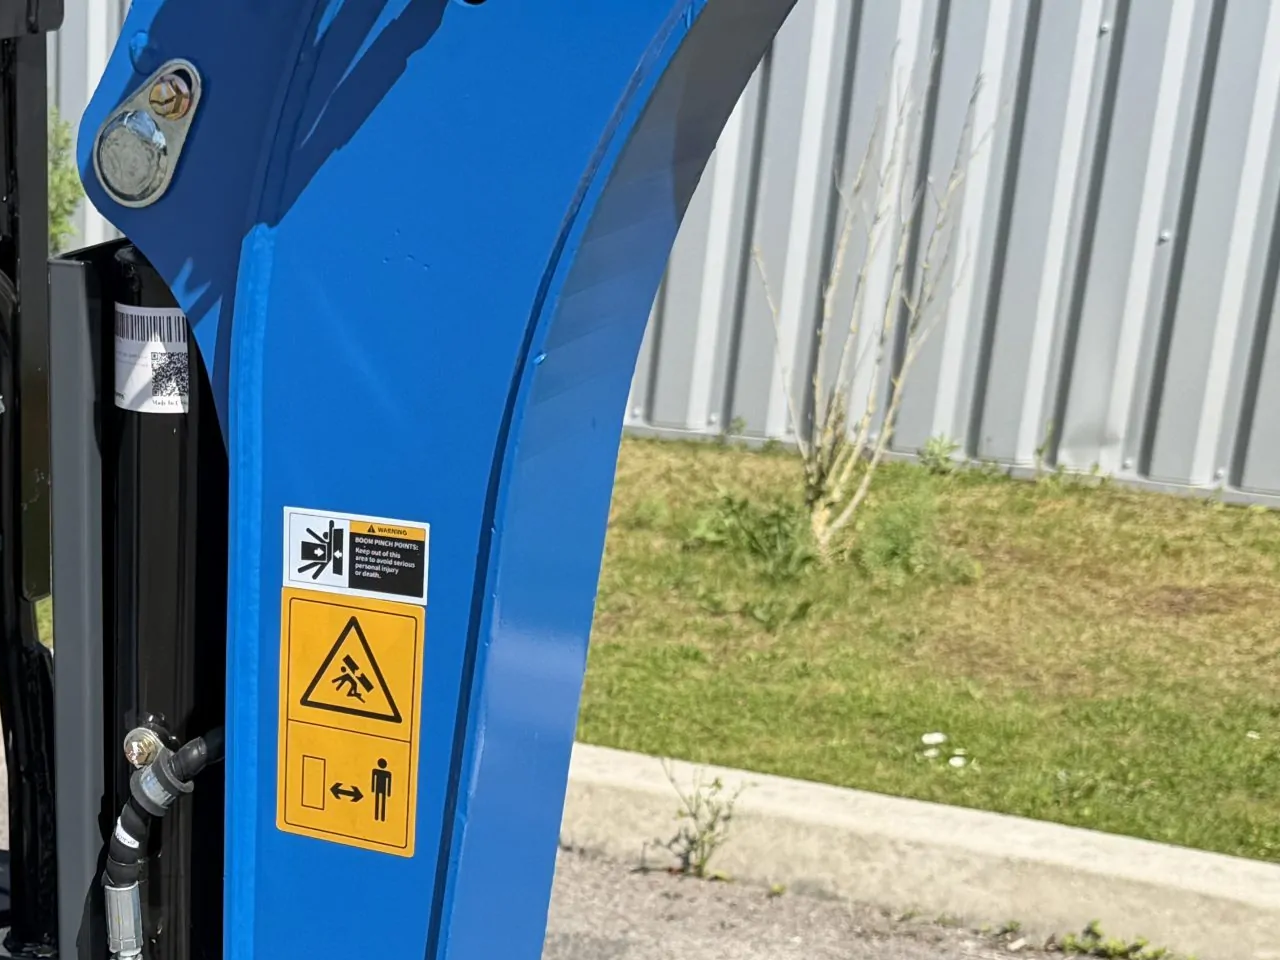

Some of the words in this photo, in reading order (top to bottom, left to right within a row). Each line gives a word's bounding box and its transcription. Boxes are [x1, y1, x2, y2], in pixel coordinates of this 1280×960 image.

[377, 527, 408, 536] WARNING
[355, 537, 373, 545] BOOM
[374, 539, 393, 547] PINCH
[355, 547, 370, 555] Keep
[376, 557, 393, 565] avoid
[393, 560, 416, 568] serious
[355, 563, 381, 571] personal
[382, 566, 399, 575] injury
